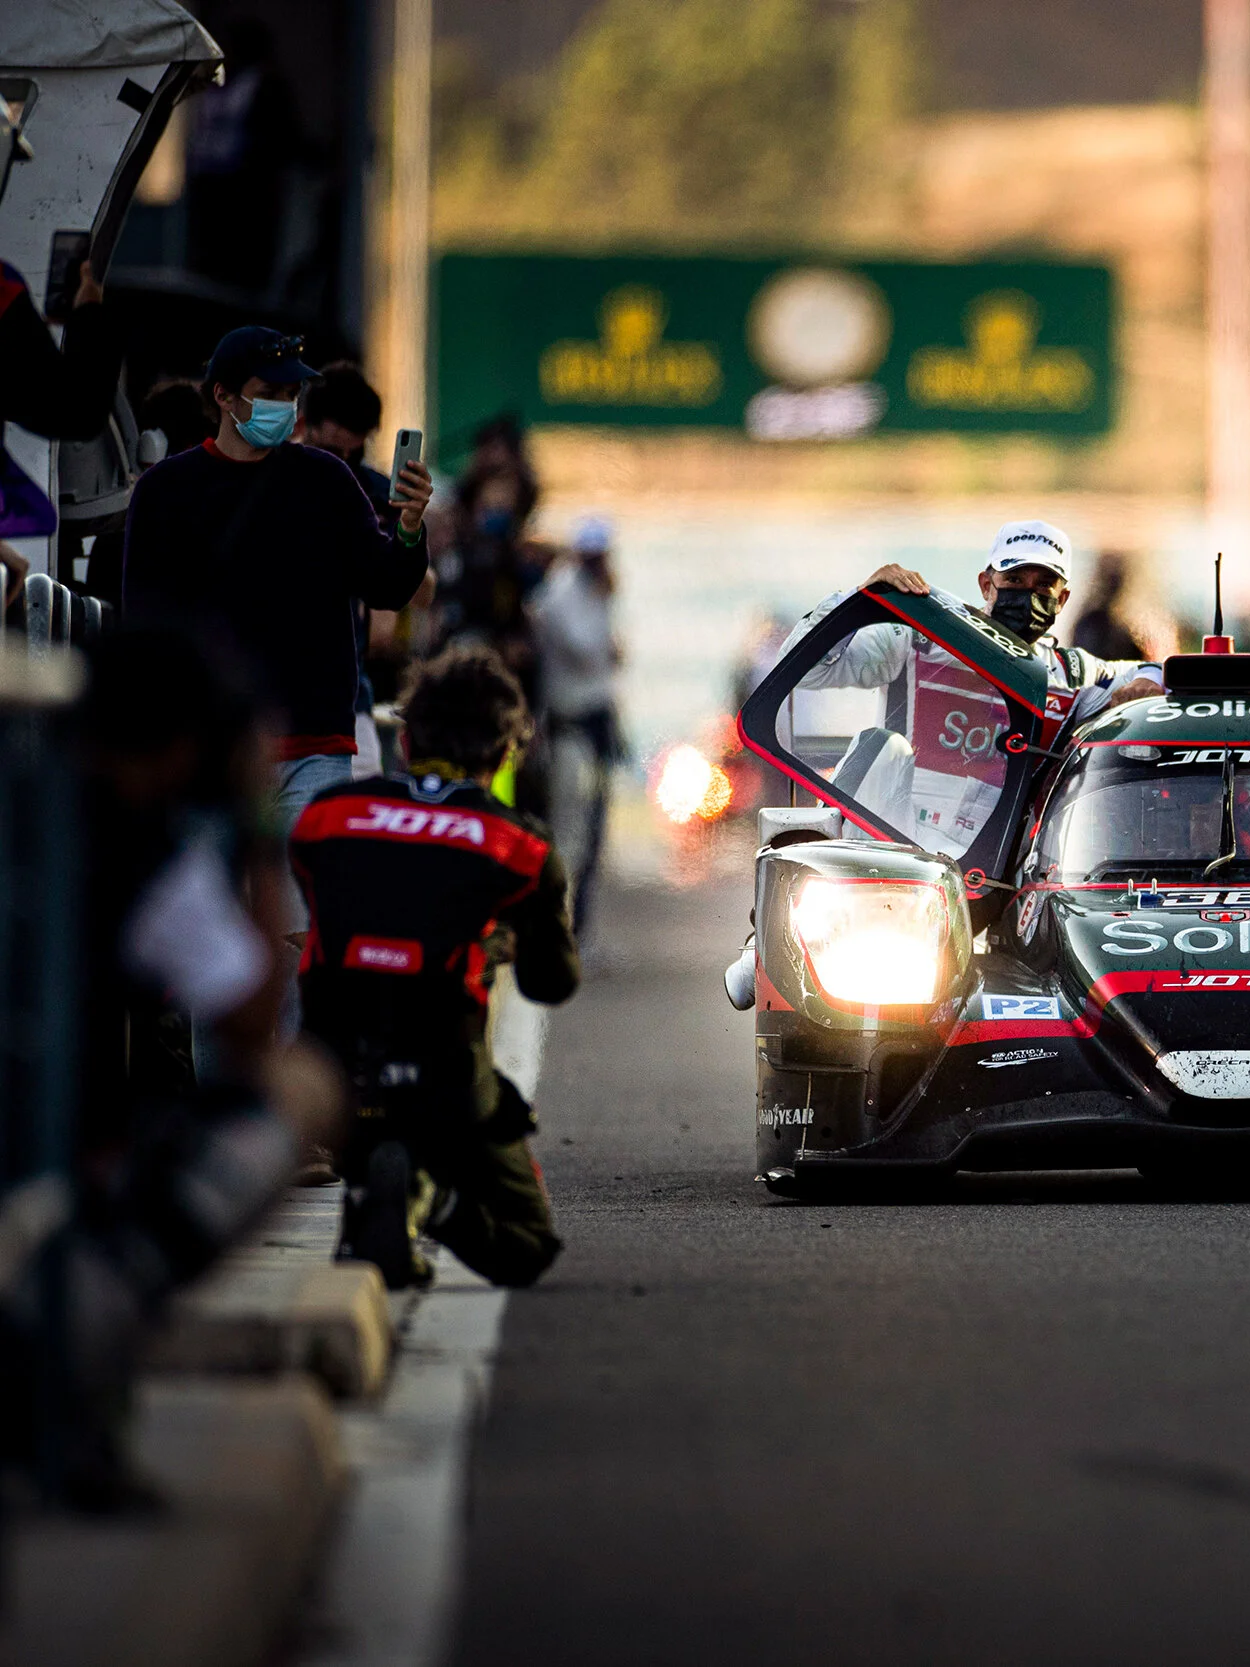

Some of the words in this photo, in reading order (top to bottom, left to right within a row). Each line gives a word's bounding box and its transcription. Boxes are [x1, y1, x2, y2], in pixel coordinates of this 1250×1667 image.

[1006, 534, 1063, 555] GOODYEAR
[347, 803, 485, 845] JOTA
[990, 998, 1052, 1015] P2
